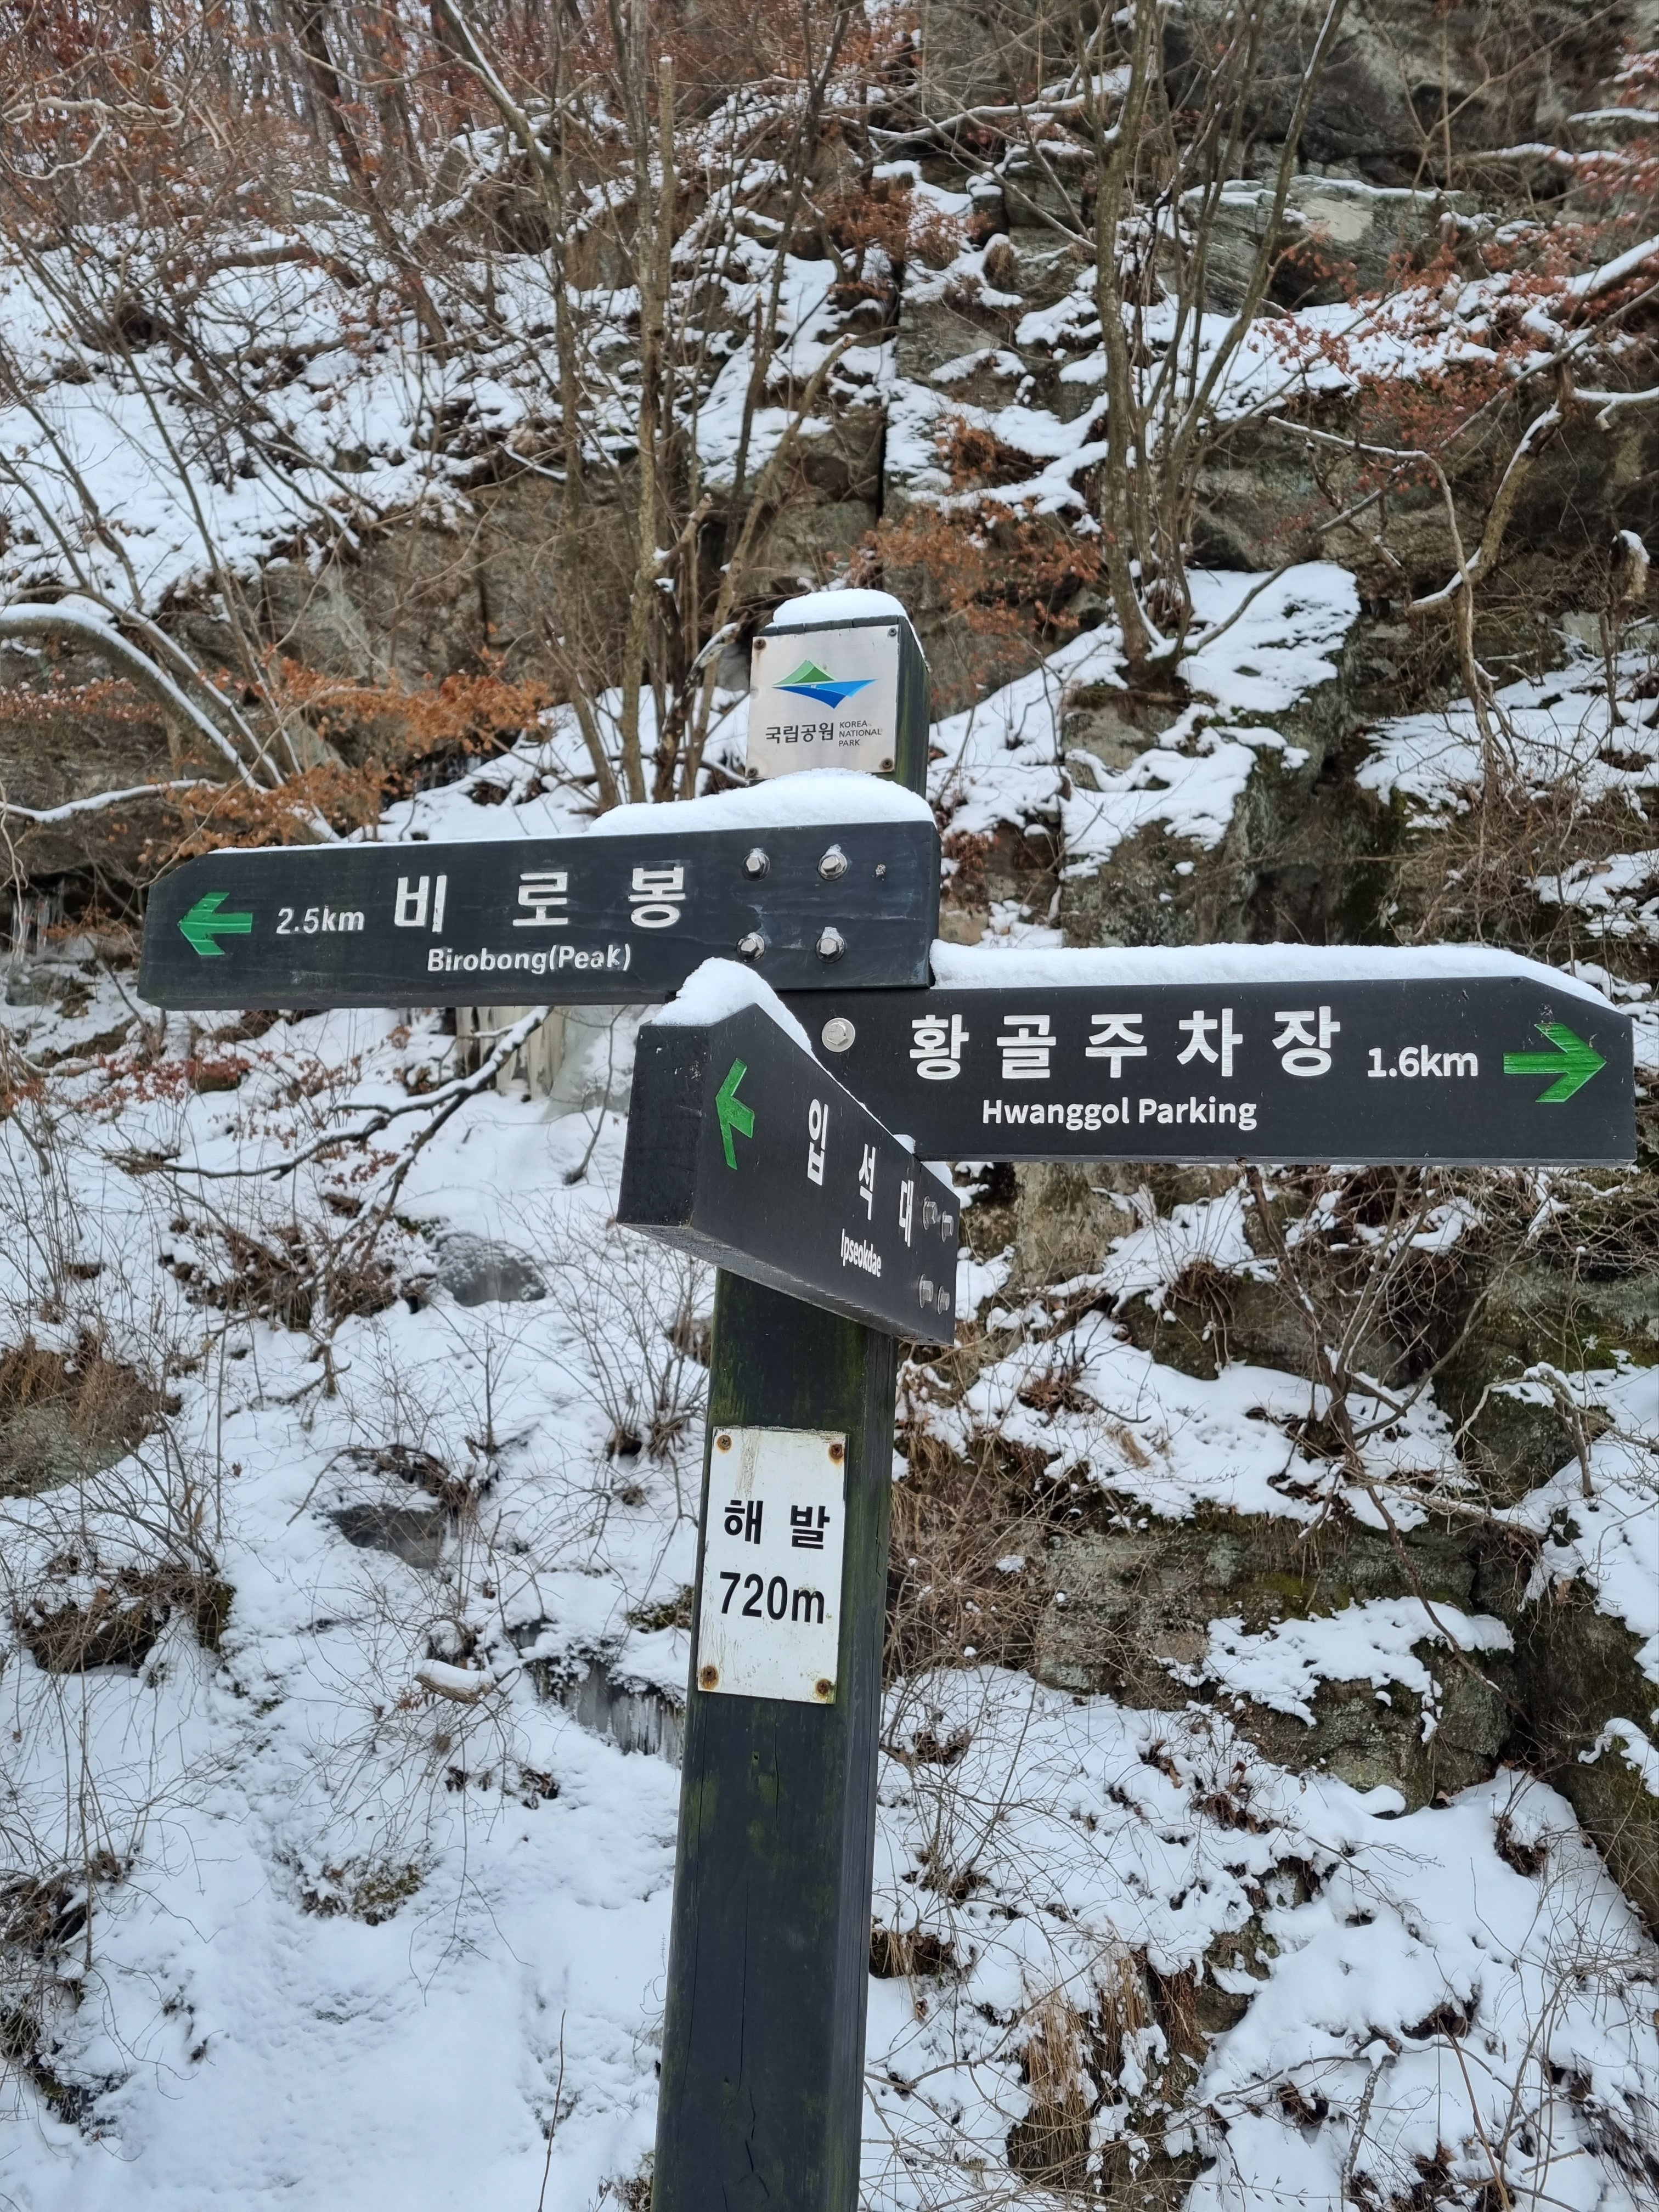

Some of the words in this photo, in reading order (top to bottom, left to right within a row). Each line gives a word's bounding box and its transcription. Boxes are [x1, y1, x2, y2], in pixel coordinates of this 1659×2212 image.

[765, 722, 834, 744] 국립공원
[839, 720, 867, 729] KOREA
[839, 728, 882, 738] NATIONAL
[276, 904, 365, 934] 2.5km
[427, 942, 631, 974] Birobong(Peak)
[909, 1006, 1340, 1080] 황골주차장
[1367, 1044, 1478, 1077] 1.6km
[983, 1097, 1129, 1131] Hwanggol
[1139, 1096, 1257, 1131] Parking
[840, 1228, 882, 1278] Ipseokdae
[719, 1571, 824, 1624] 720m
